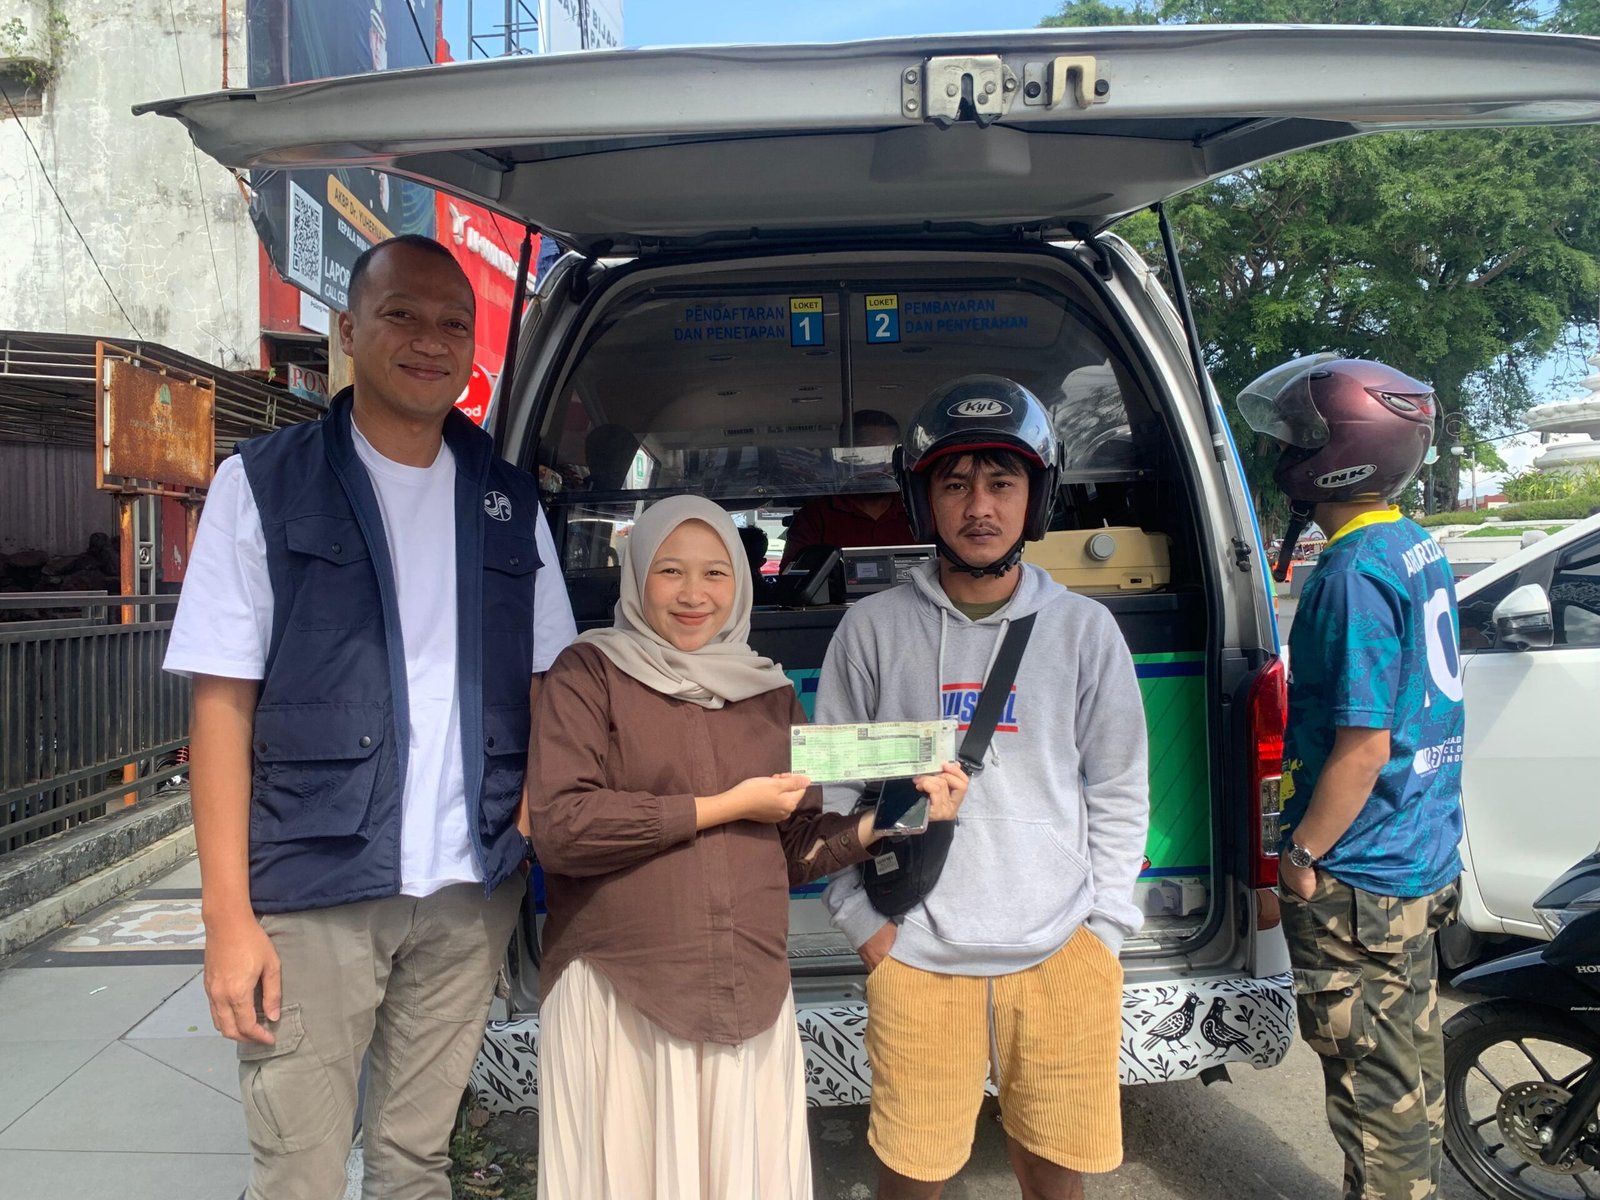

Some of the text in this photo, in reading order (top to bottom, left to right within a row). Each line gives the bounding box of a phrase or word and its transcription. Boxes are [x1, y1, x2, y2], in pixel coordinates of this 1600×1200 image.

[324, 284, 337, 301] CALL
[793, 302, 819, 310] LOKET
[869, 298, 894, 307] LOKET
[904, 299, 996, 315] PEMBAYARAN
[685, 306, 785, 322] PENDAFTARAN
[674, 325, 785, 341] DAN PENETAPAN
[799, 316, 811, 341] 1
[875, 313, 891, 338] 2
[905, 316, 1029, 334] DAN PENYERAHAN
[1321, 466, 1368, 485] INK
